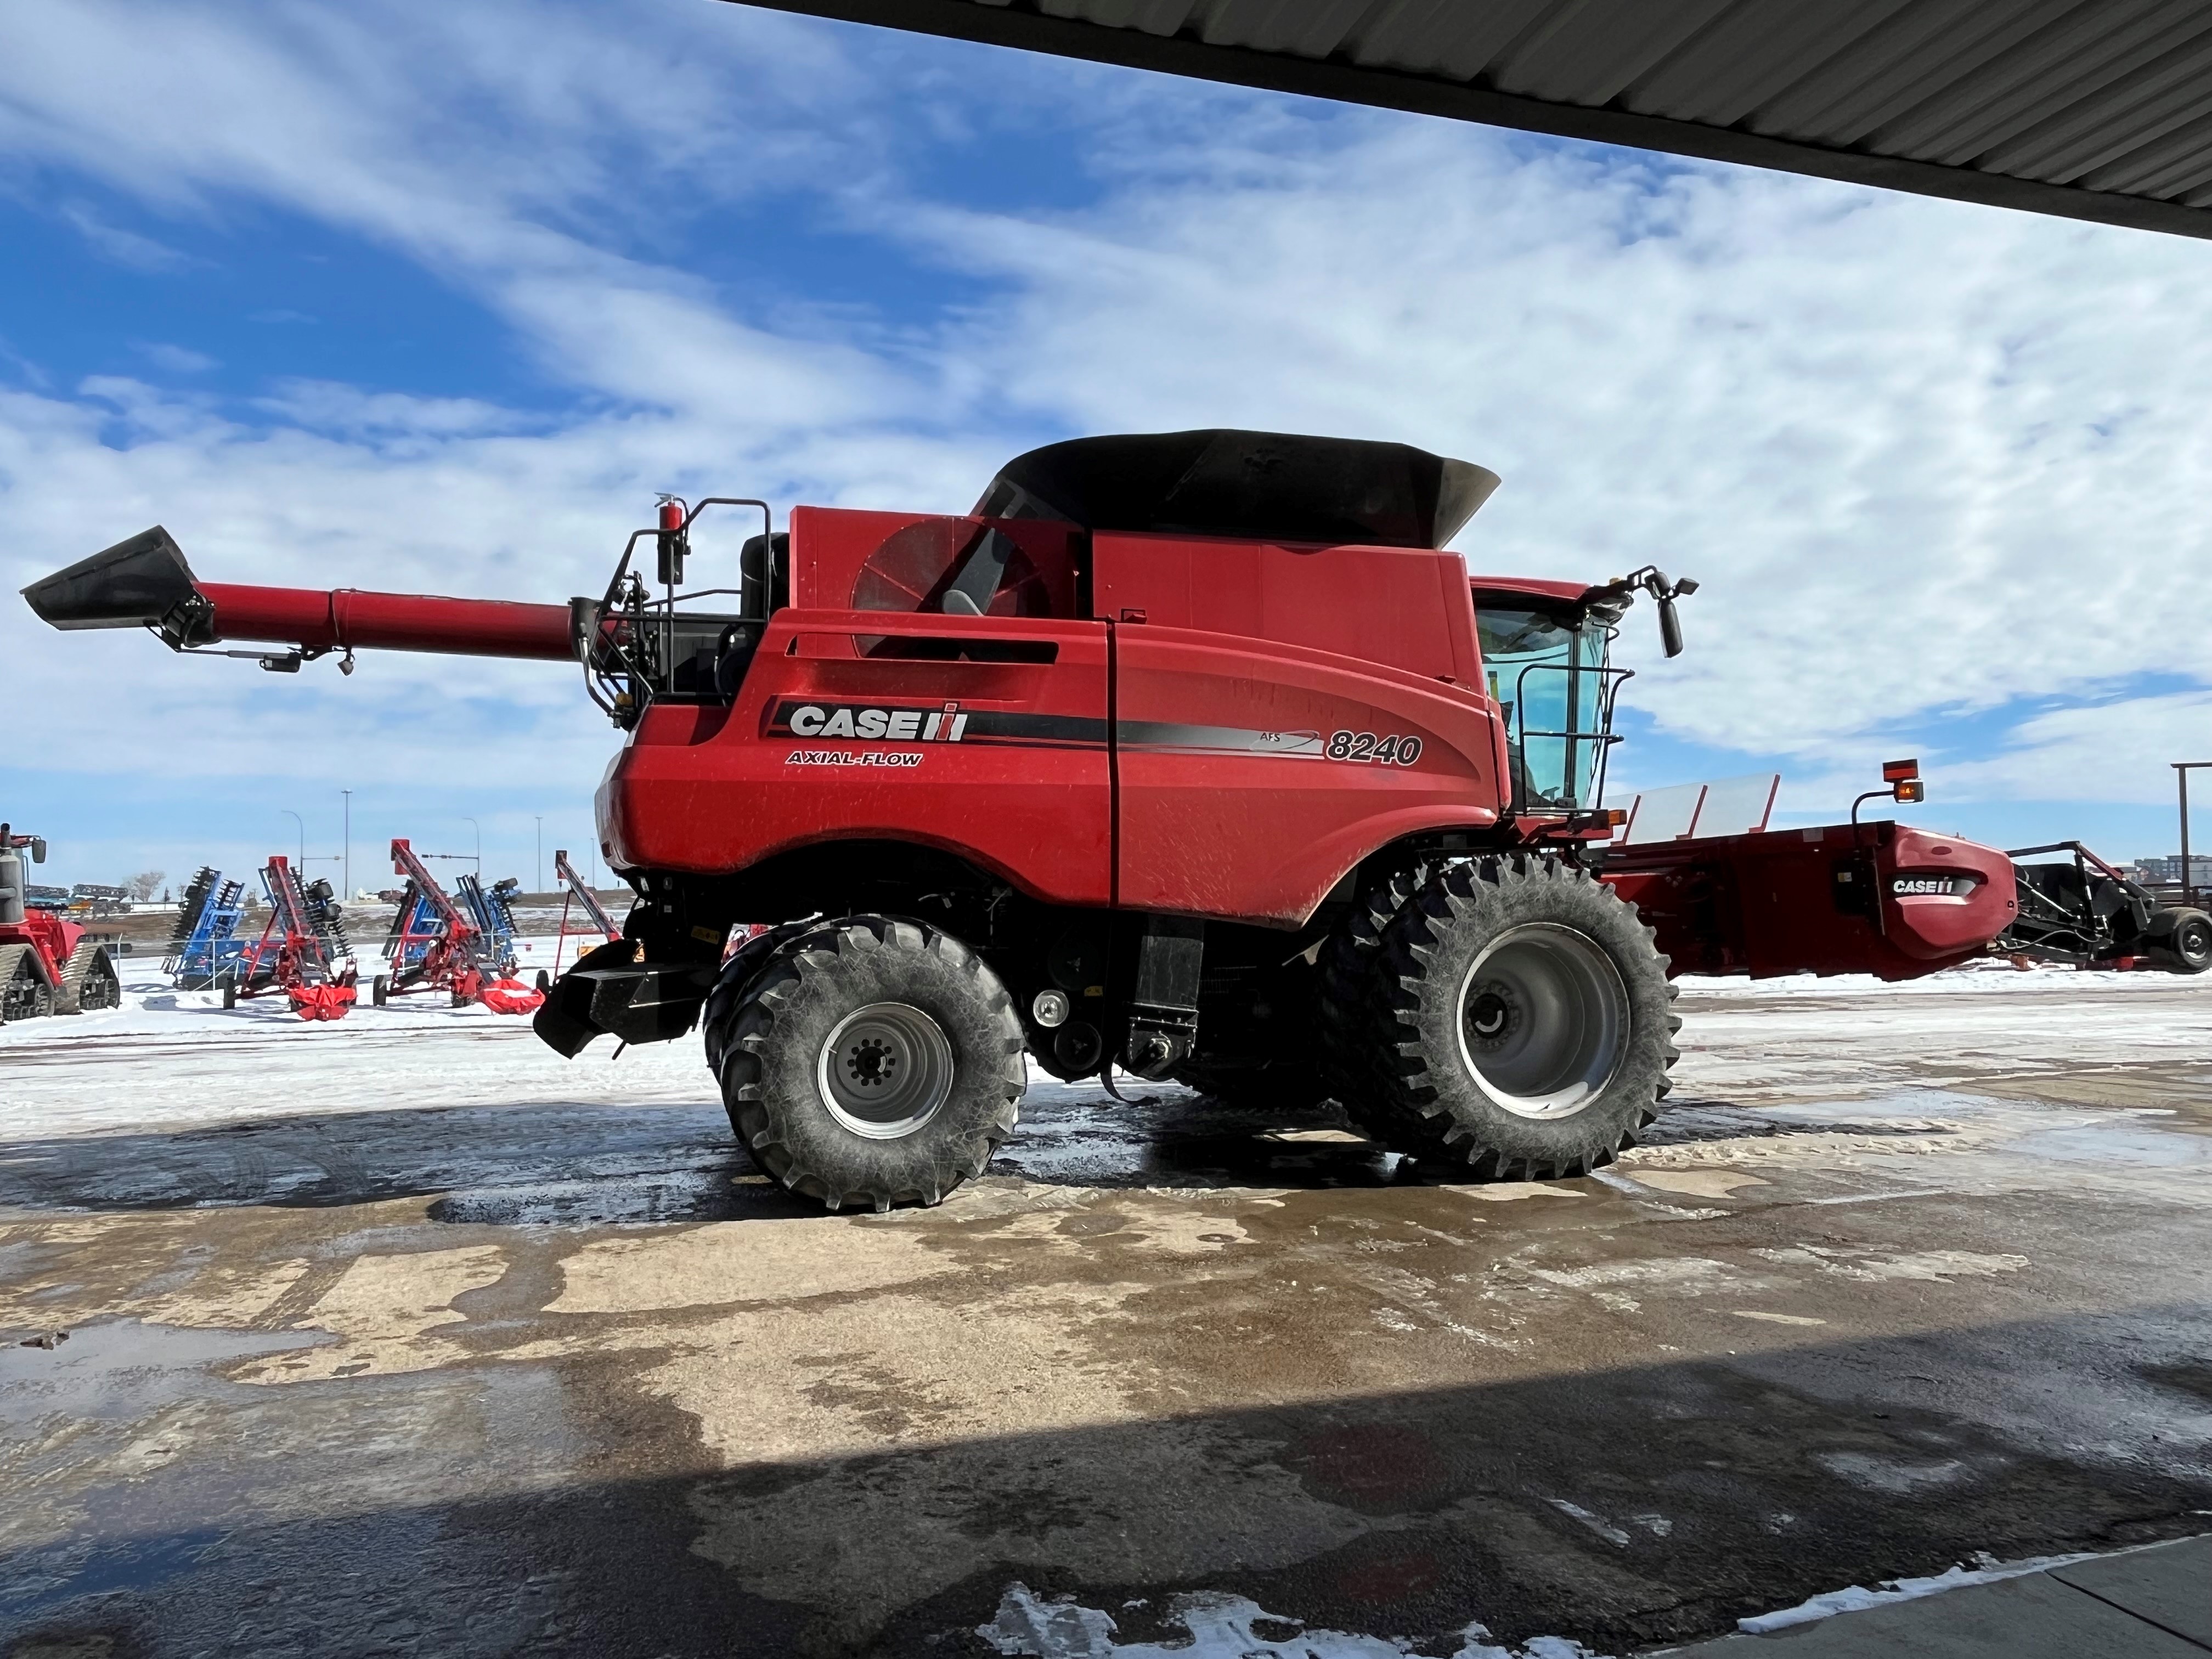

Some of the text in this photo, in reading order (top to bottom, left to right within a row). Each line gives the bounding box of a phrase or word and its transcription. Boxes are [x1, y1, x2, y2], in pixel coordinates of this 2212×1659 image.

[789, 706, 922, 740] CASE
[1260, 732, 1281, 742] AFS
[1326, 730, 1423, 766] 8240
[785, 750, 923, 767] AXIAL-FLOW
[1893, 880, 1937, 893] CASE
